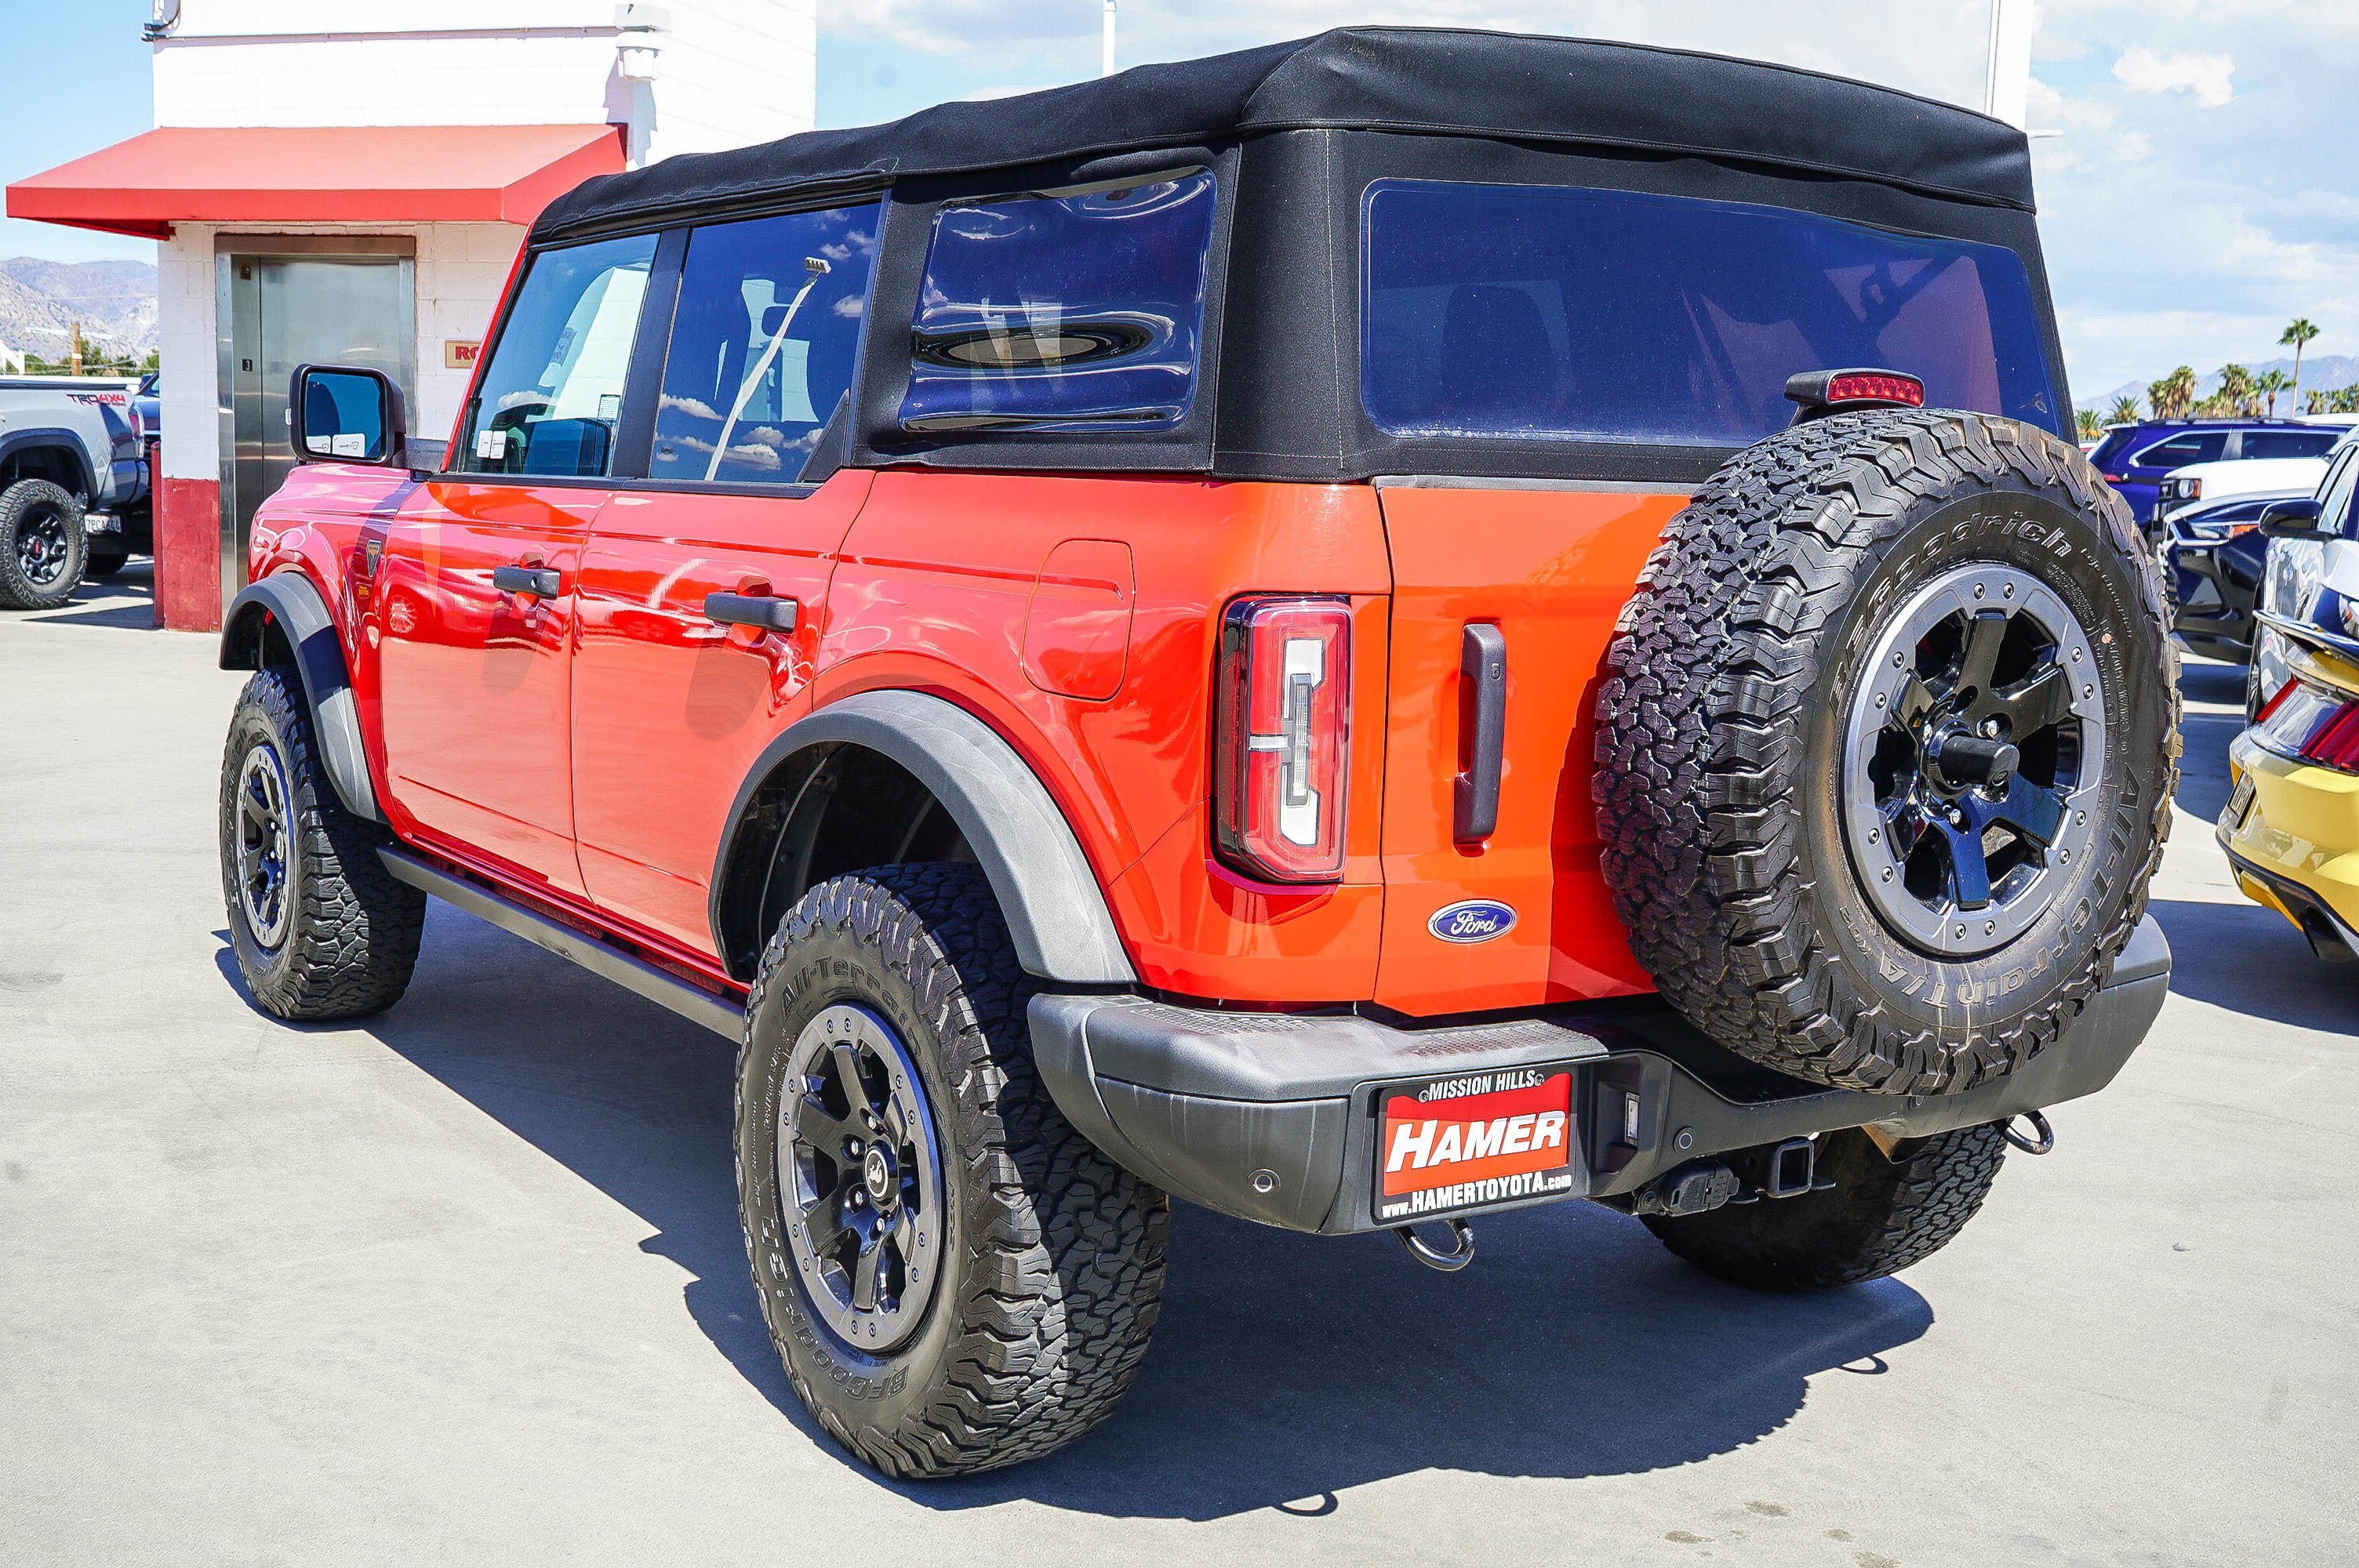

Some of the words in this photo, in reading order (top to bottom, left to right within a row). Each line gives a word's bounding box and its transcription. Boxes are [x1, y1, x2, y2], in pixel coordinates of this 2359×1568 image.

[245, 361, 250, 370] 3
[1830, 511, 2072, 719] BFGoodrich
[1957, 762, 2141, 1007] All-Terrain
[1451, 910, 1499, 935] Ford
[781, 956, 921, 1057] All-Terrain
[1878, 952, 1948, 1009] T/A
[1428, 1075, 1492, 1101] MISSION
[1496, 1070, 1536, 1092] HILLS
[1386, 1110, 1565, 1173] HAMER
[1382, 1171, 1572, 1218] www.HAMERTOYOTA.com
